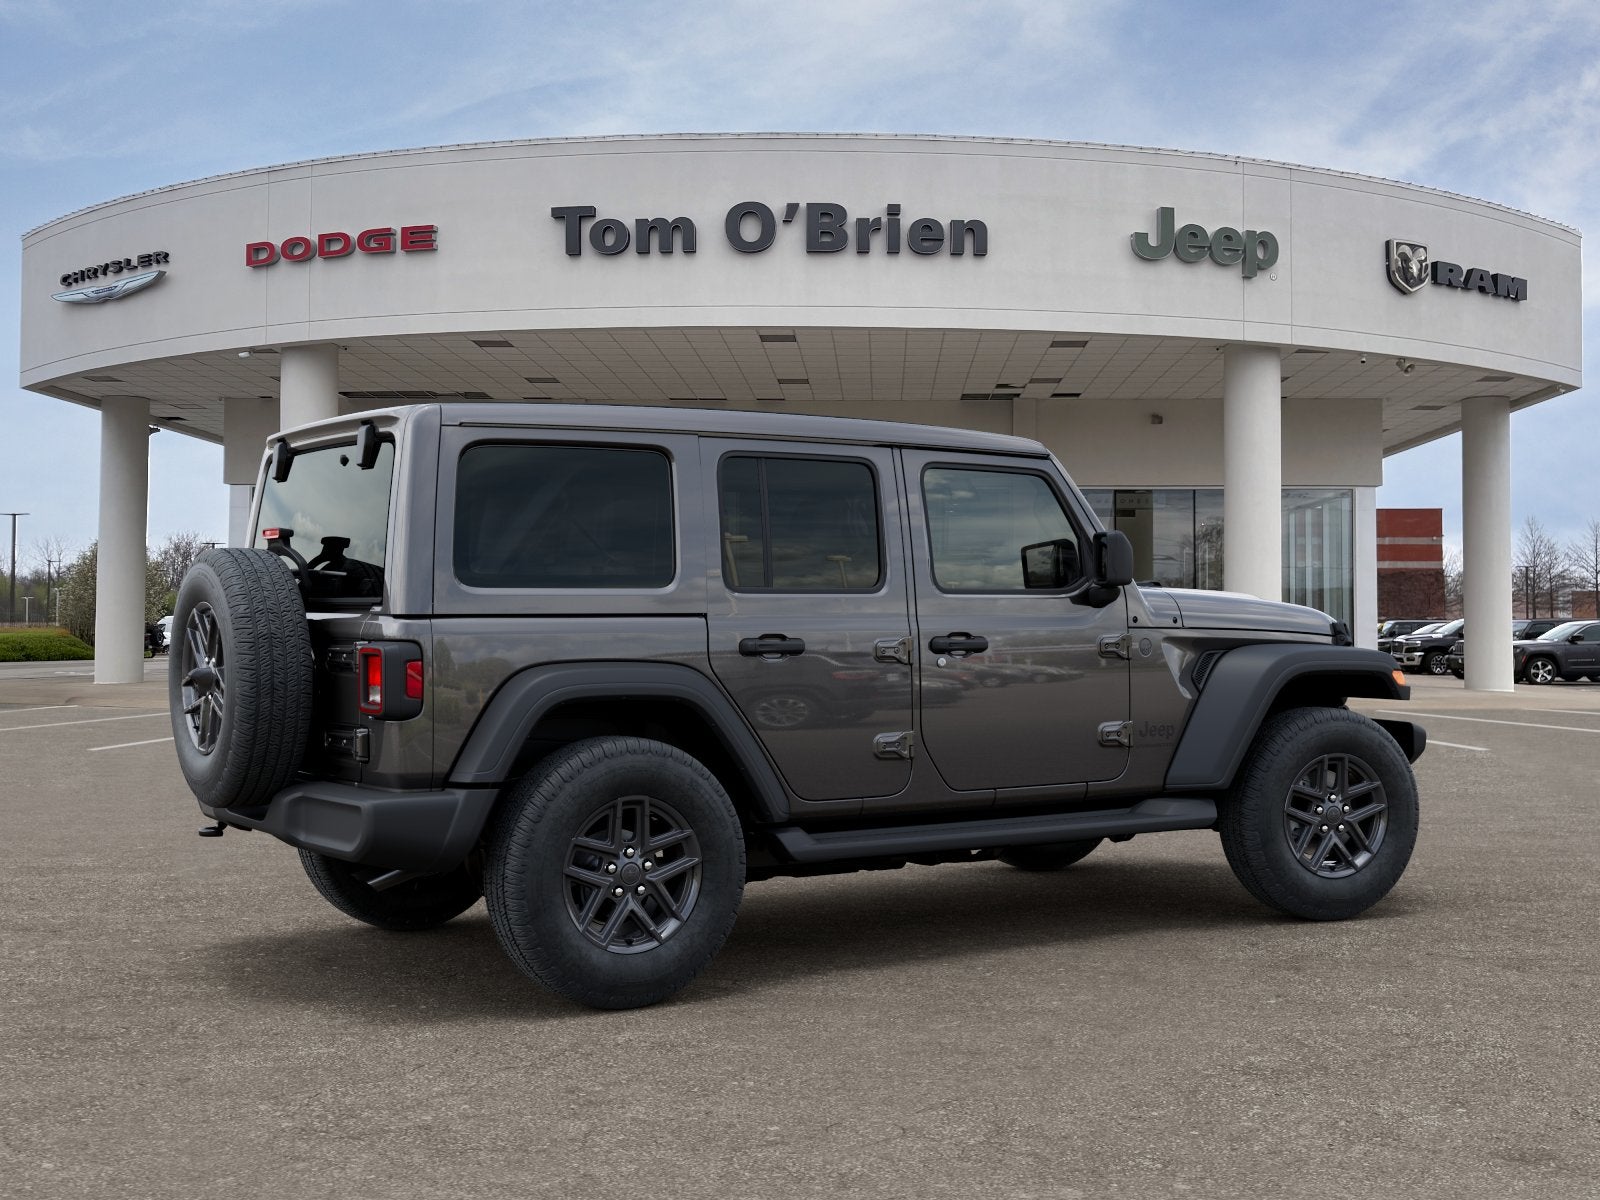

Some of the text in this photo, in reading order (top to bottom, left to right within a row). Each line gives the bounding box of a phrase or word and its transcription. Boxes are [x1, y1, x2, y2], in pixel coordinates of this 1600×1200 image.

[246, 224, 438, 268] DODGE
[551, 201, 988, 257] Tom O'Brien
[1130, 206, 1279, 278] Jeep
[60, 251, 170, 286] CHRYSLER
[1430, 260, 1528, 301] RAM
[1138, 721, 1175, 740] Jeep
